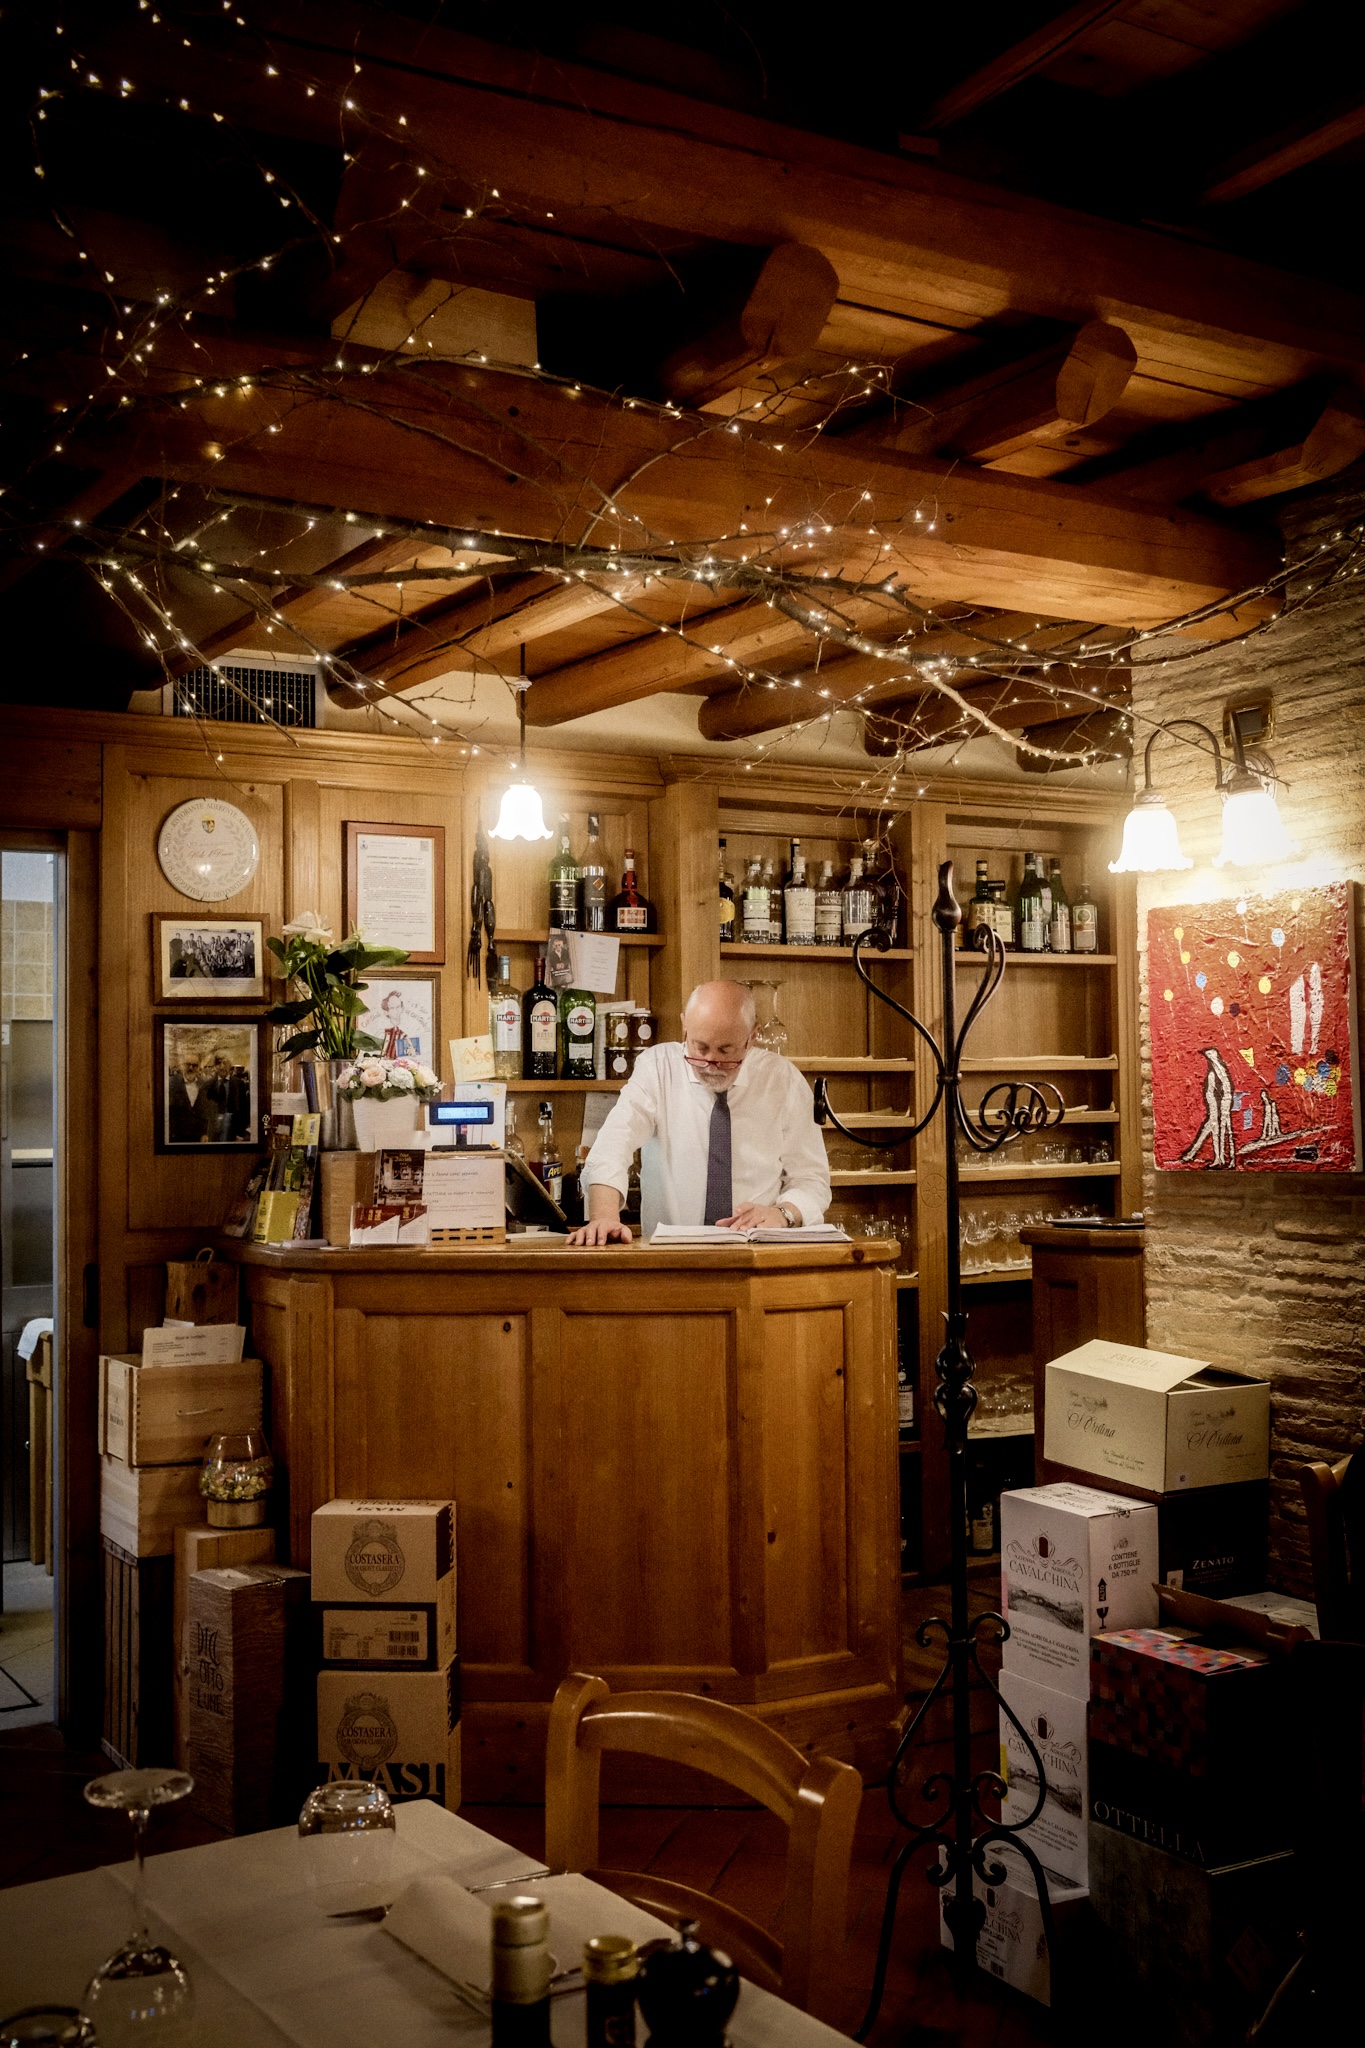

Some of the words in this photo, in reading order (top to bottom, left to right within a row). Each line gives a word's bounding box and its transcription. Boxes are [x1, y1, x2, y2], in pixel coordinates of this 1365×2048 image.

[171, 803, 204, 827] RISTORANTE
[349, 1554, 400, 1565] COSTASERA
[1111, 1551, 1138, 1561] CONTIENE
[1114, 1559, 1141, 1570] BOTTIGLIE
[1192, 1556, 1234, 1570] ZENATO
[1009, 1560, 1079, 1593] CAVALCHINA
[1111, 1571, 1119, 1579] DA
[1120, 1570, 1130, 1578] 750
[200, 1660, 224, 1691] OTTO
[197, 1688, 225, 1715] LUNE
[341, 1726, 392, 1738] COSTASERA
[1008, 1738, 1078, 1777] CAVCHINA
[328, 1762, 441, 1796] MASI
[1093, 1800, 1205, 1863] OTTELLA
